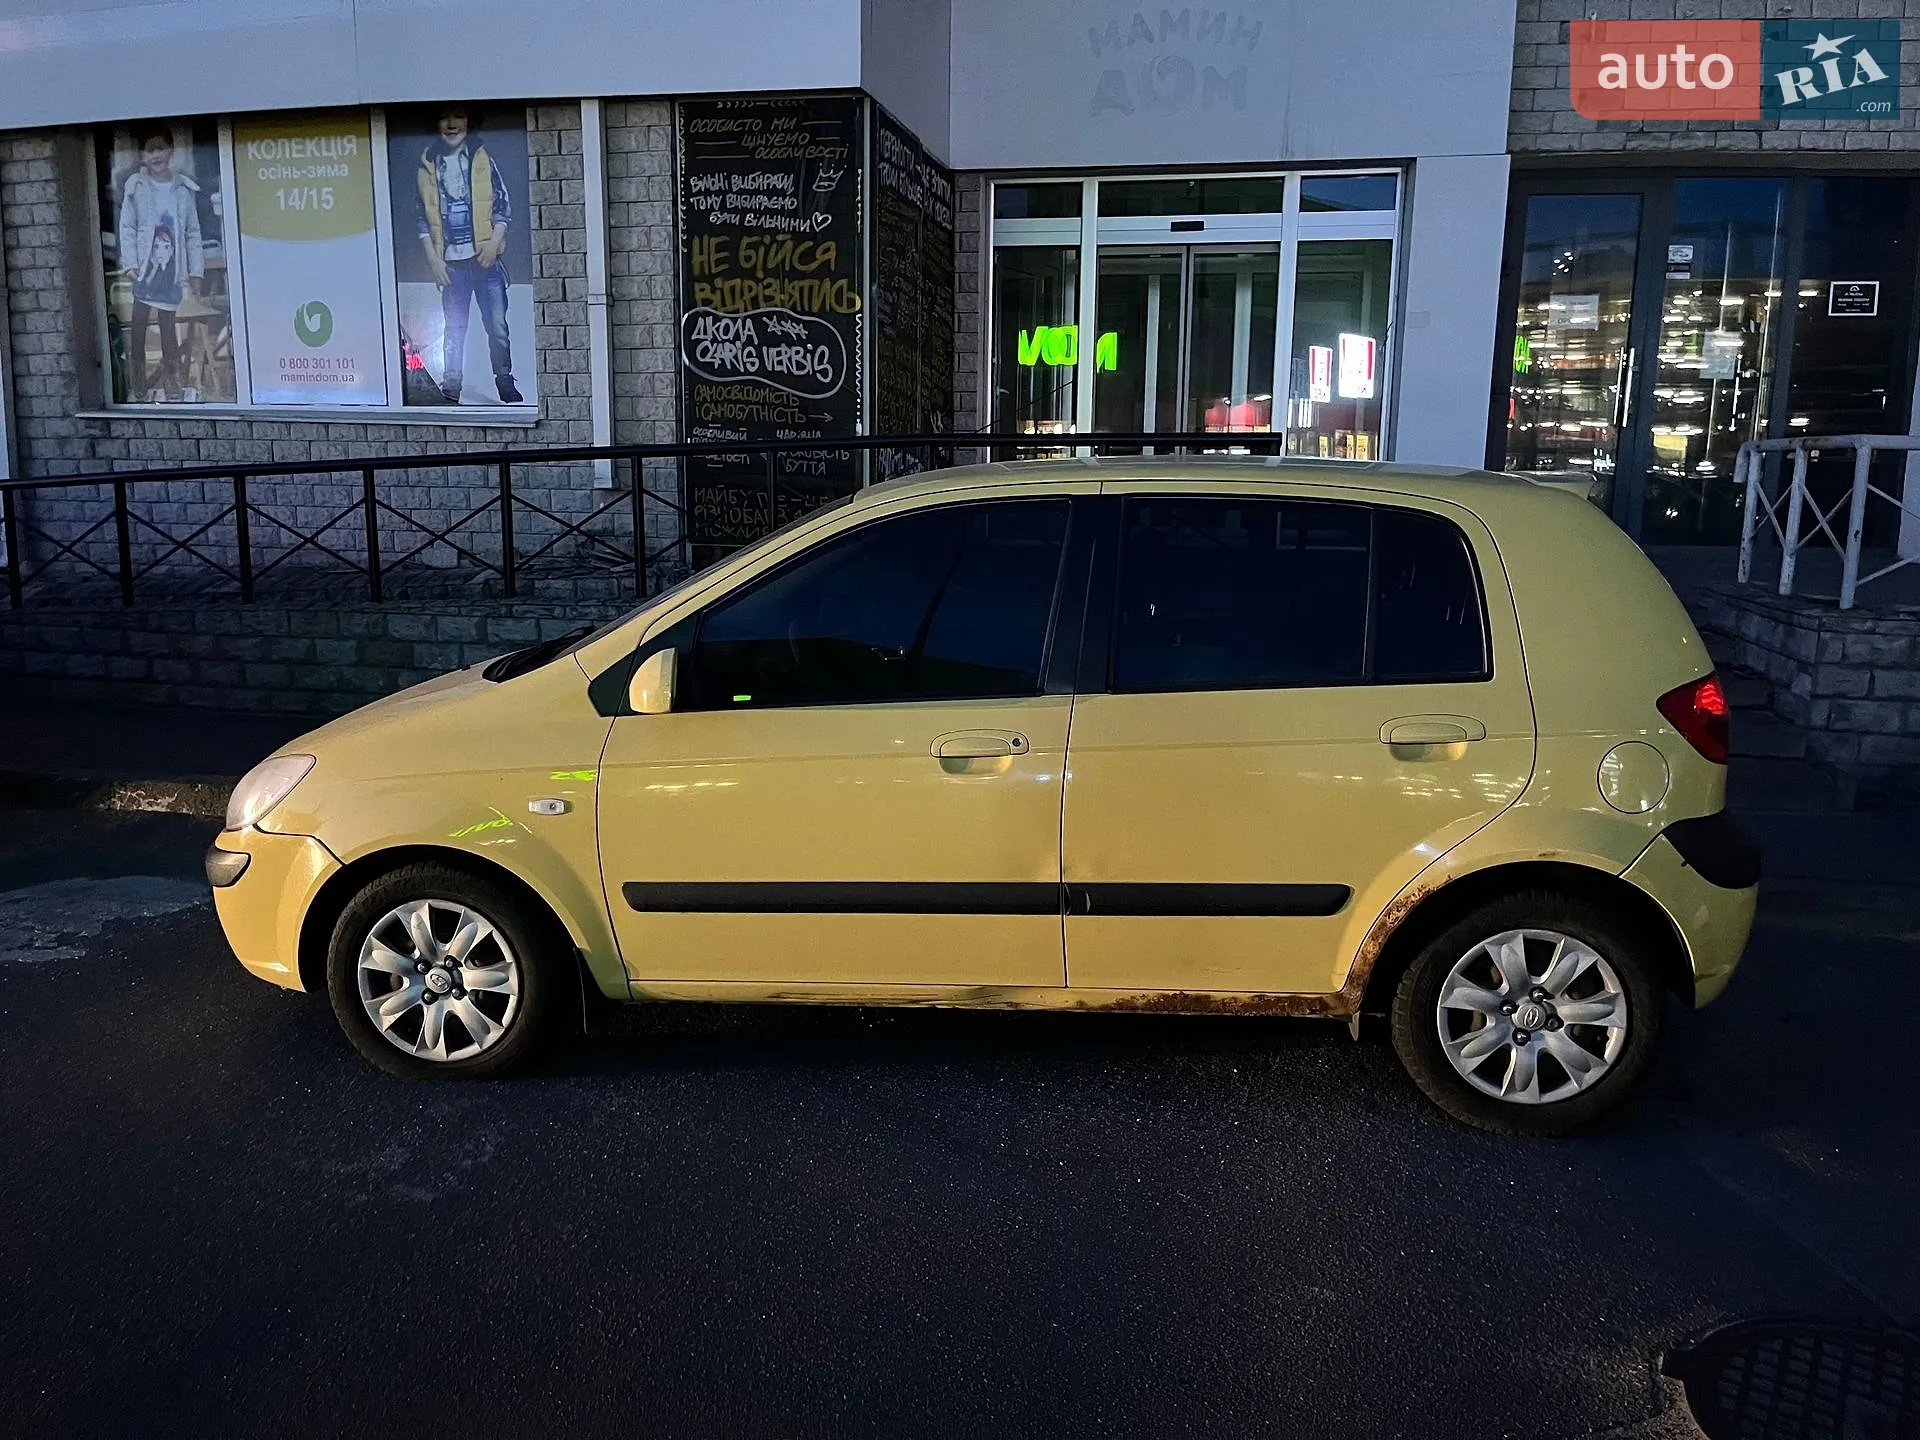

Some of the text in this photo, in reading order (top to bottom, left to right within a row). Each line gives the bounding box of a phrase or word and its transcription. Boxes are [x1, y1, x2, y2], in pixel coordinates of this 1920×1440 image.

[1088, 8, 1263, 58] МАМИН
[690, 117, 797, 133] ОСОБИСТО МИ
[248, 135, 357, 161] КОЛЕКЦІЯ
[258, 163, 349, 181] осінь-зима
[276, 186, 335, 212] 14/15
[690, 194, 723, 211] ТОМУ
[692, 234, 837, 279] НЕ БІЙСЯ
[279, 357, 355, 370] 0 800 301 101
[280, 371, 355, 384] mamindom.ua
